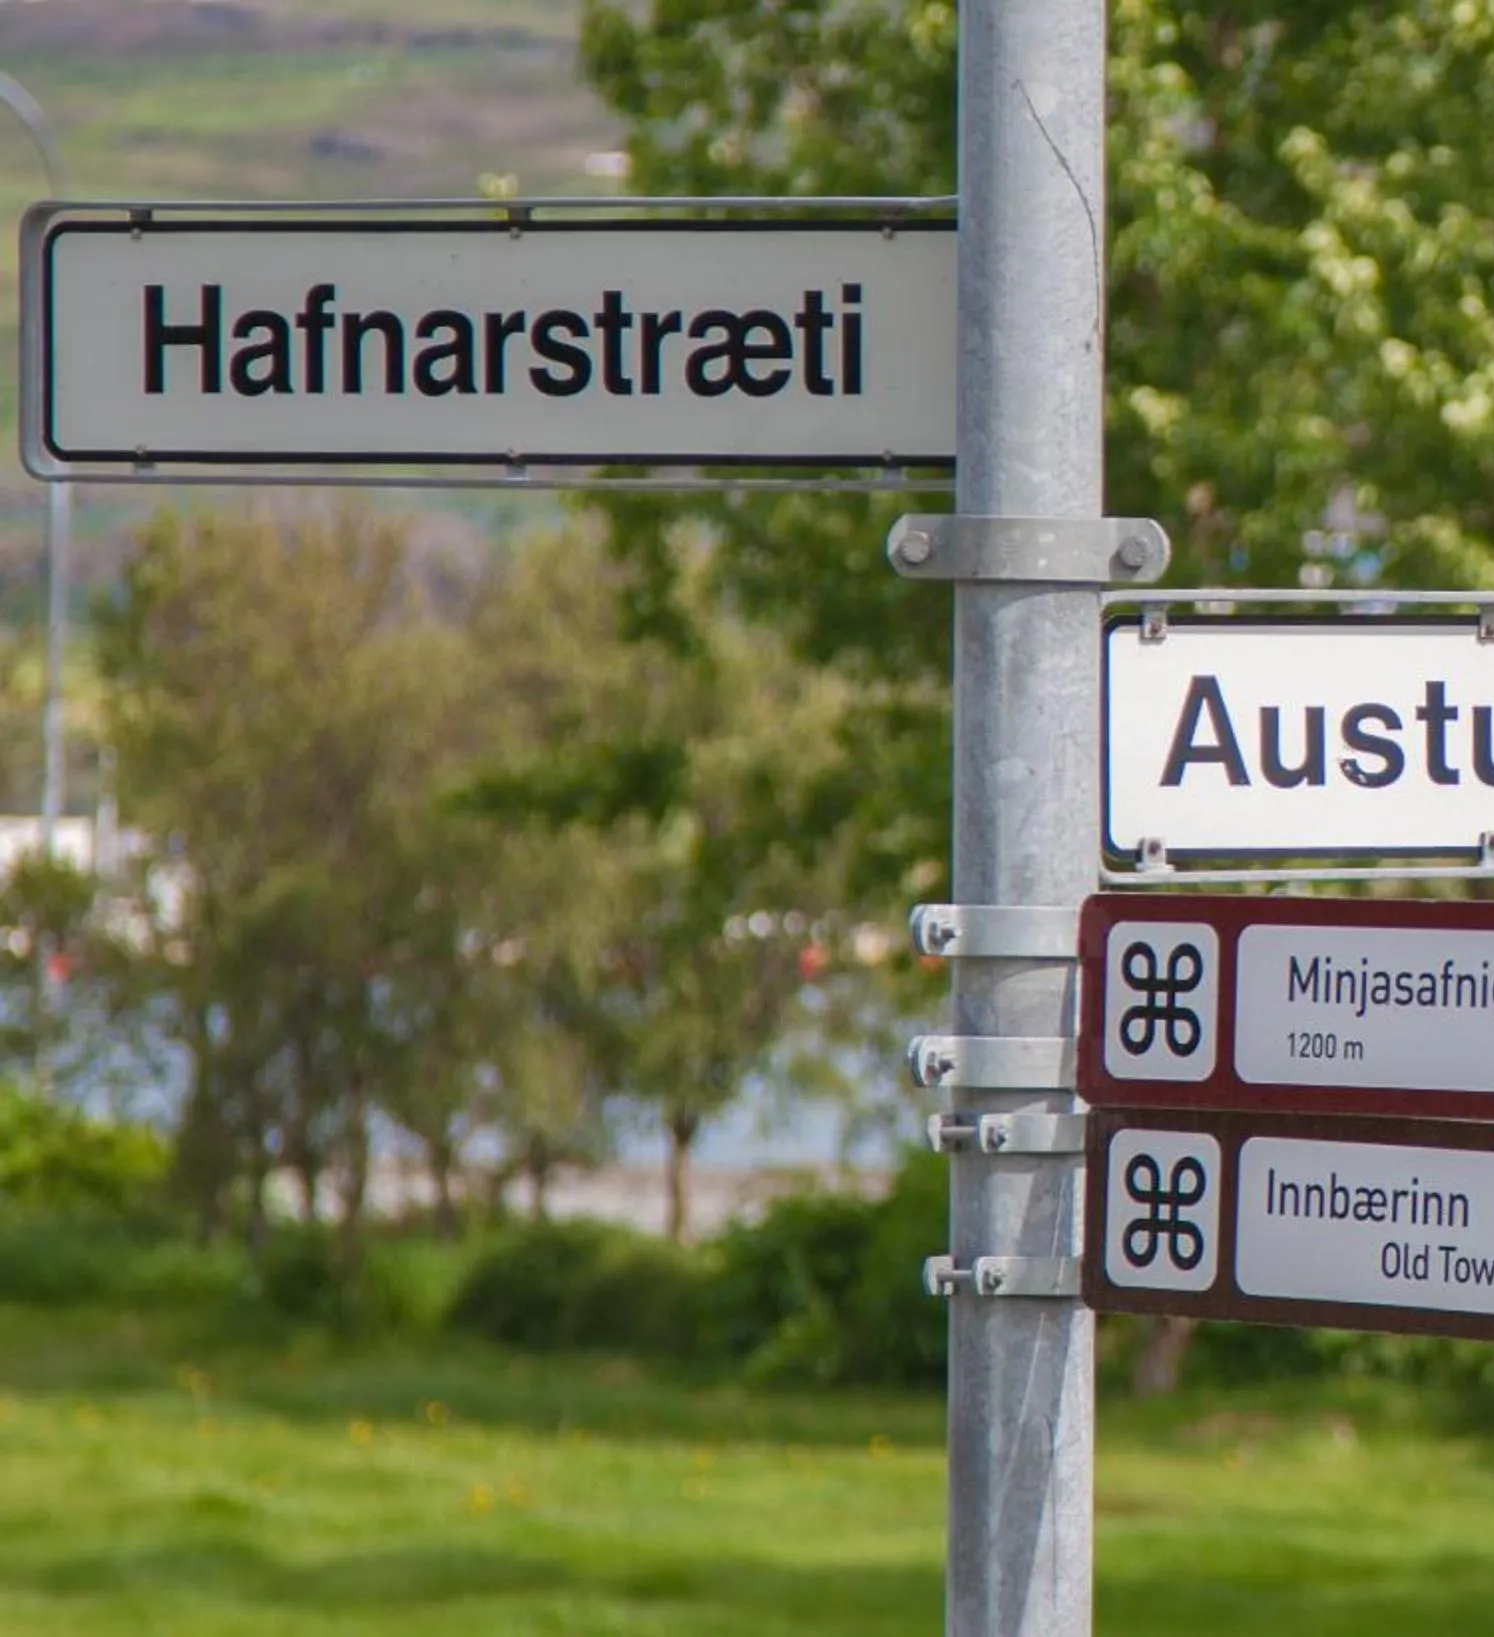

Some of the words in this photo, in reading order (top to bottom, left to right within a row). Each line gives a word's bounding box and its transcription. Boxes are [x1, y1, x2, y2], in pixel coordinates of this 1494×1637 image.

[144, 282, 863, 399] Hafnarstræti
[1287, 1032, 1337, 1059] 1200
[1343, 1040, 1364, 1061] m
[1266, 1167, 1469, 1228] Innbærinn
[1381, 1241, 1430, 1281] Old
